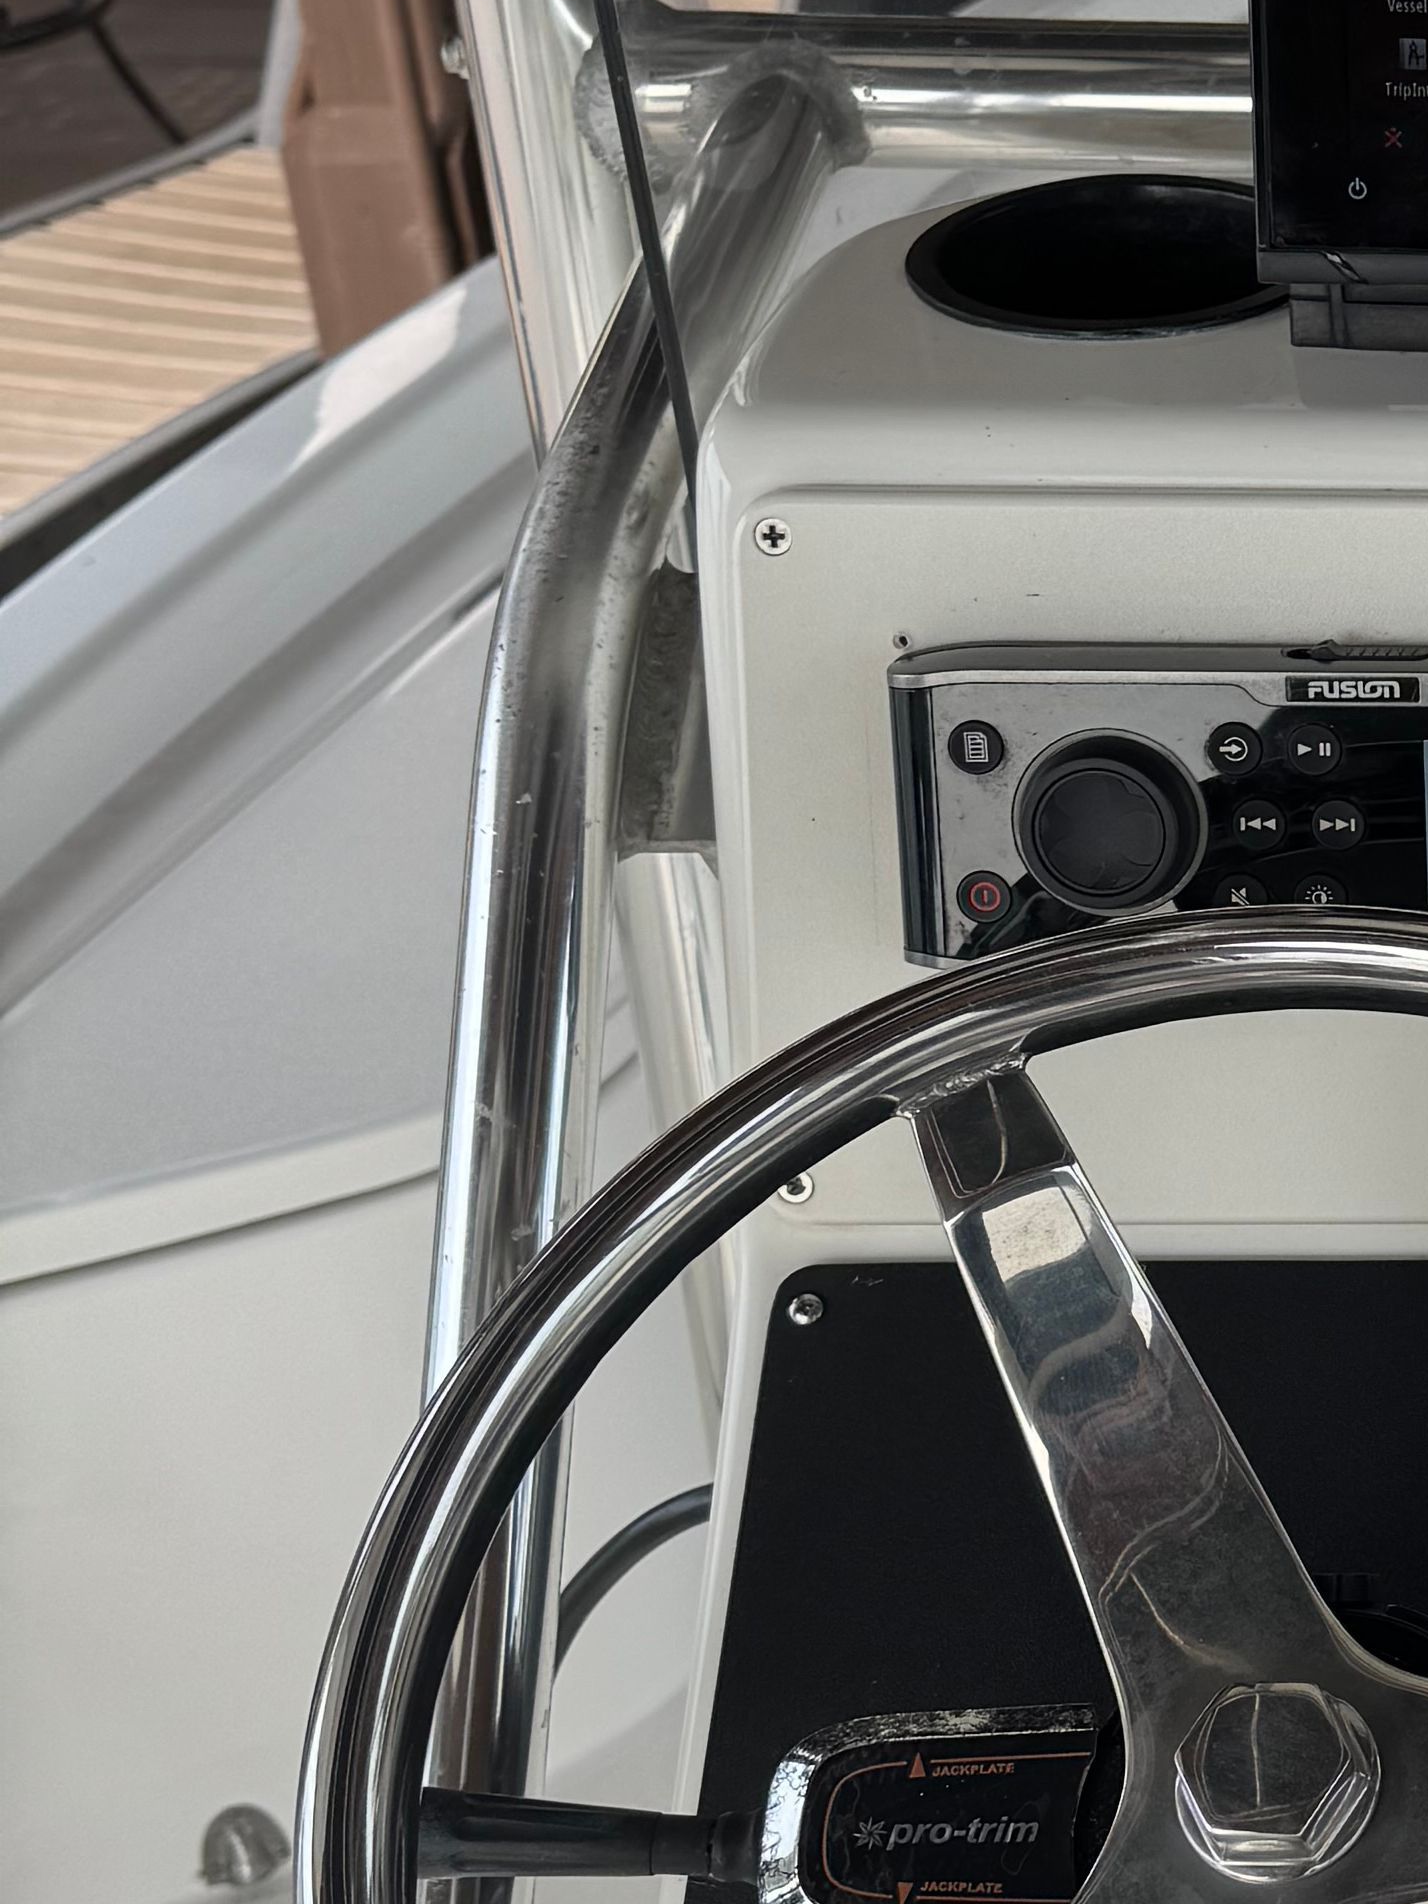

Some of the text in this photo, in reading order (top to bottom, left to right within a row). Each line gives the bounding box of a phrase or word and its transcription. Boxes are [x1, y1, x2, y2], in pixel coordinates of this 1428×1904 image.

[931, 1761, 1016, 1778] JACKPLATE
[885, 1816, 1040, 1852] pro-trim
[920, 1880, 1004, 1895] JACKPLATE
